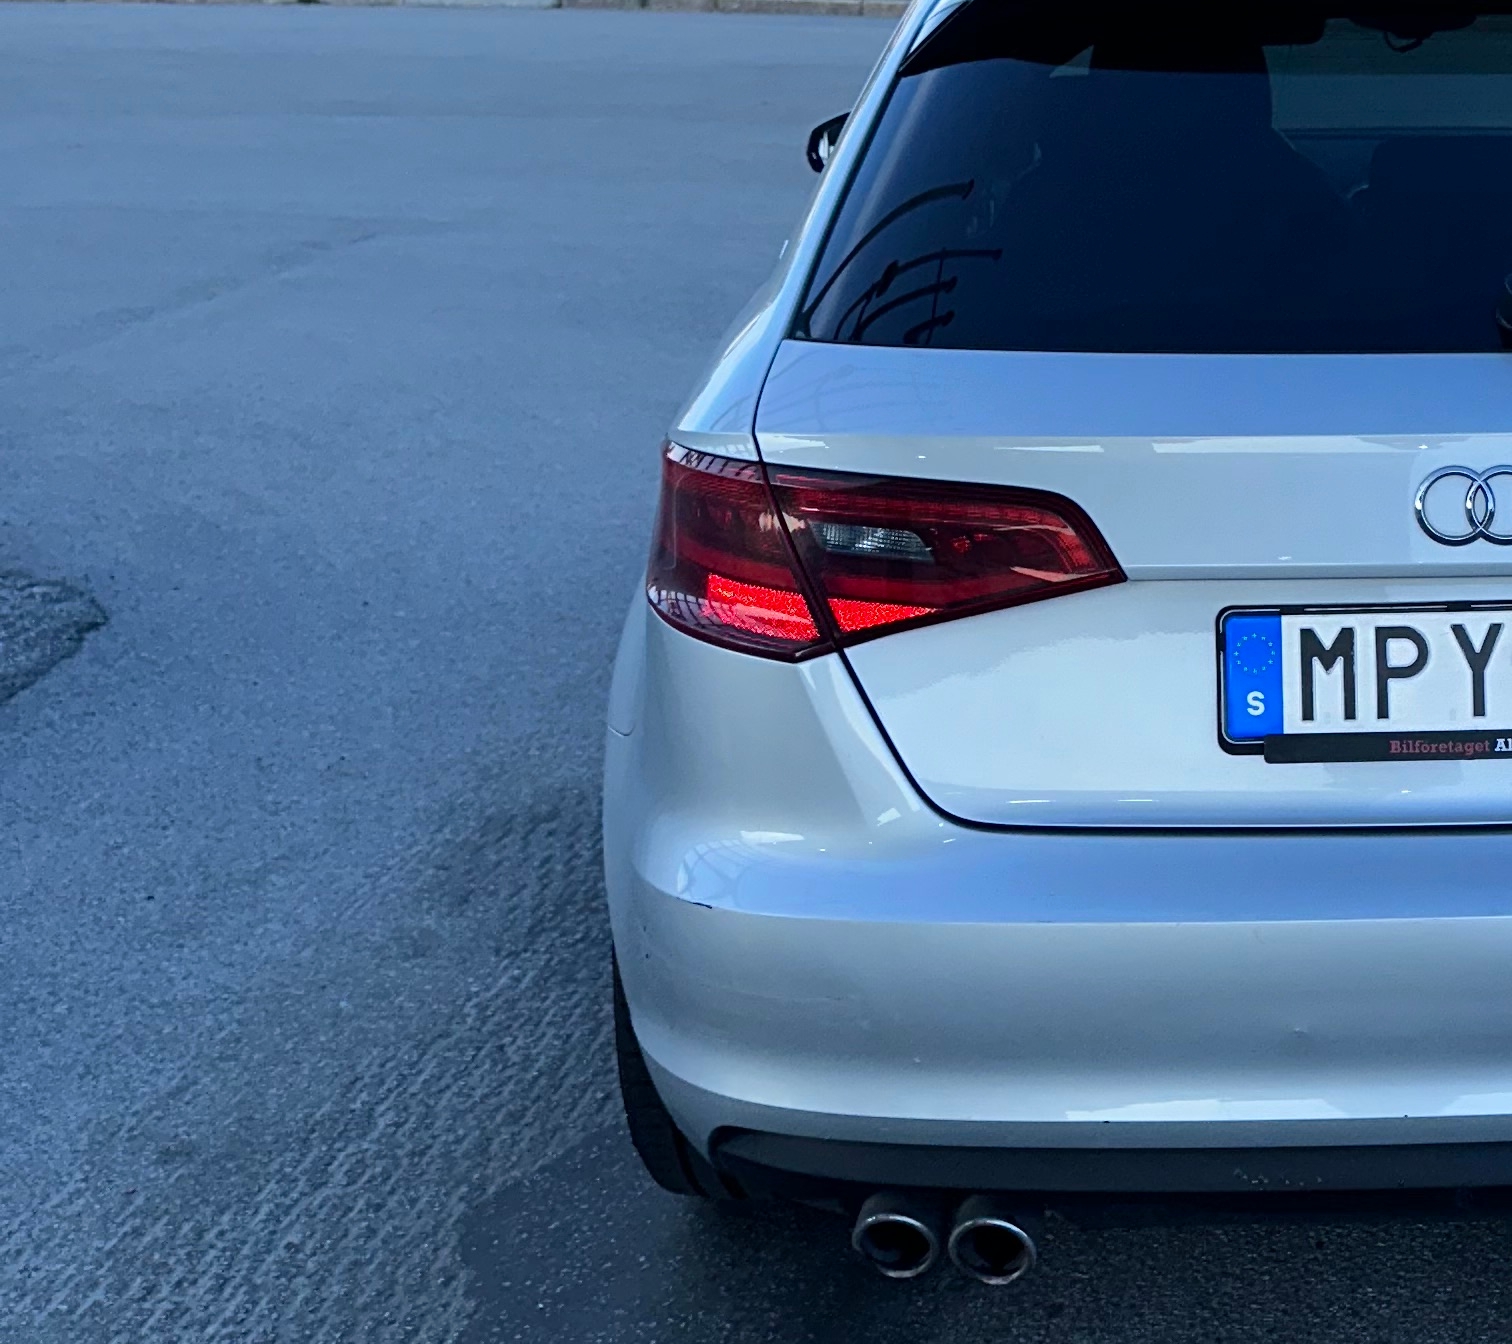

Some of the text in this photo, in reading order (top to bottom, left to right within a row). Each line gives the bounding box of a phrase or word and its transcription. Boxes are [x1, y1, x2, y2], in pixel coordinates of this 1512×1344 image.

[1299, 622, 1505, 721] MPY
[1246, 691, 1265, 716] S
[1389, 739, 1491, 755] Bilföretaget
